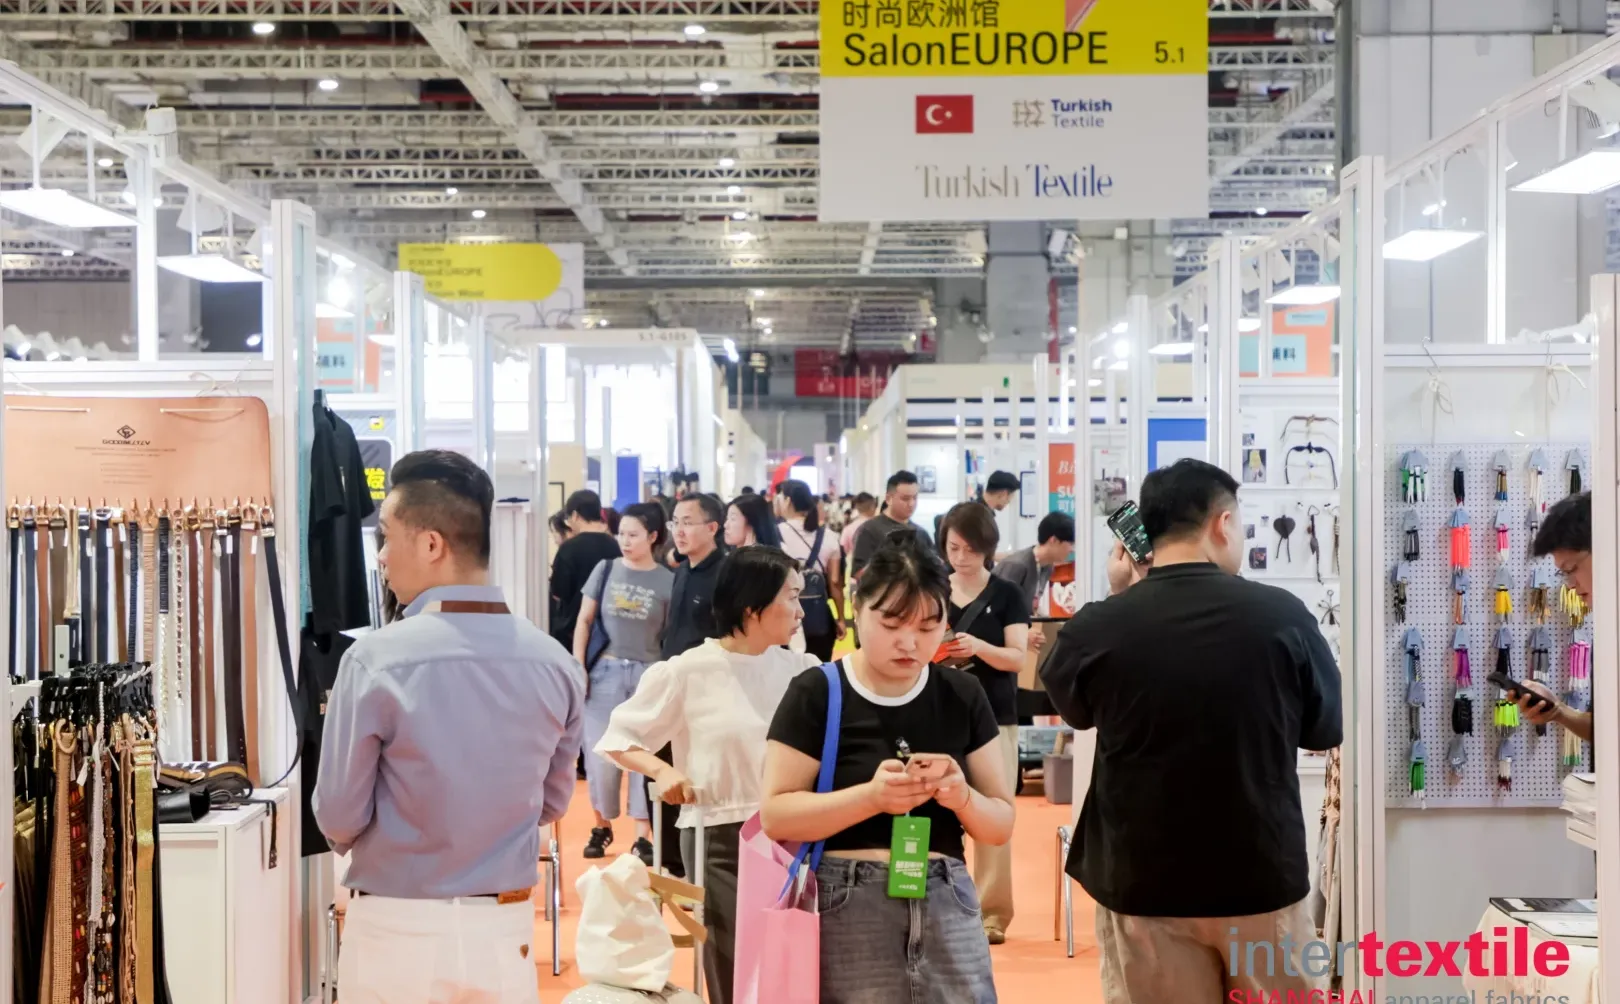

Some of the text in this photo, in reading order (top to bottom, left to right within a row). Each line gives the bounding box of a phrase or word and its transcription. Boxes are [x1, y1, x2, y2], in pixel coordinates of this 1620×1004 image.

[843, 0, 999, 28] 时尚欧洲馆
[844, 31, 1108, 67] SalonEUROPE
[1154, 41, 1185, 63] 5.1
[1051, 99, 1112, 112] Turkish
[1051, 114, 1104, 128] Textile
[915, 164, 1113, 198] Turkish Textile
